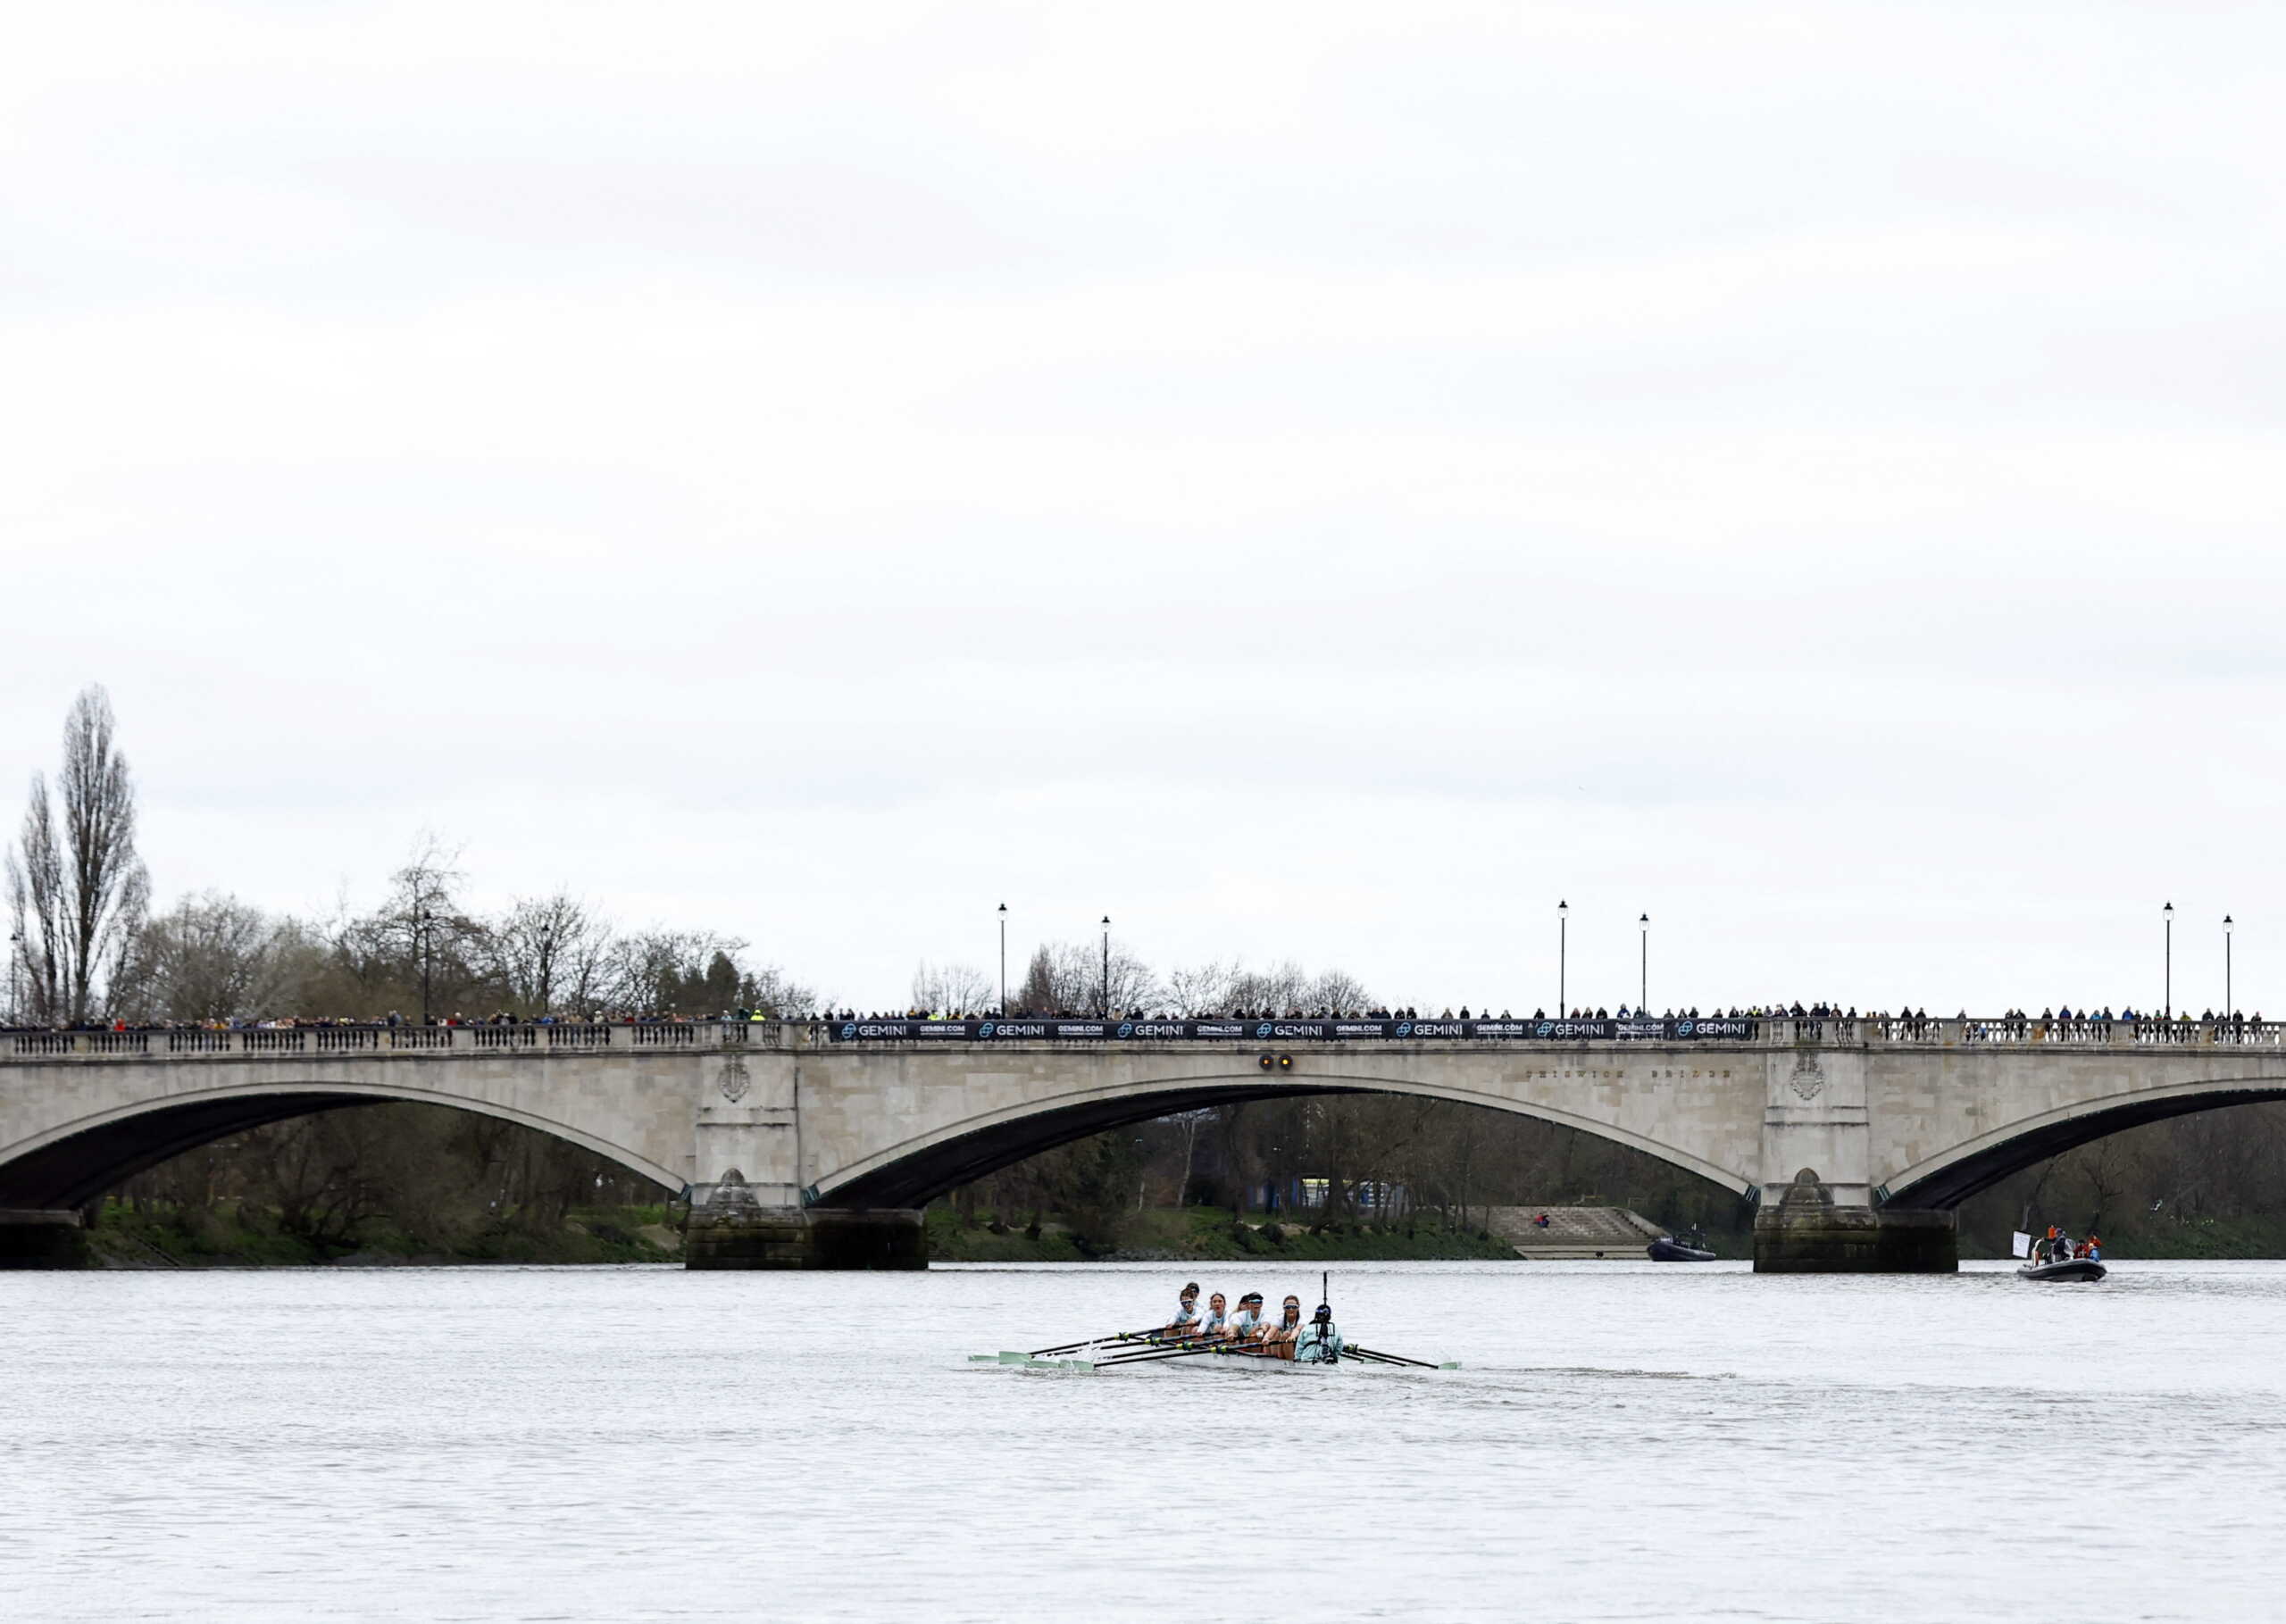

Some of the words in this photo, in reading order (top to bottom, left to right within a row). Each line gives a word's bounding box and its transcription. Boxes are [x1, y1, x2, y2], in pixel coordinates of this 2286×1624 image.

[858, 1025, 907, 1036] GEMINI
[996, 1025, 1045, 1036] GEMINI
[1135, 1025, 1184, 1036] GEMINI
[1274, 1025, 1323, 1036] GEMINI
[1414, 1024, 1463, 1035] GEMINI
[1555, 1024, 1605, 1035] GEMINI
[1696, 1023, 1746, 1034] GEMINI
